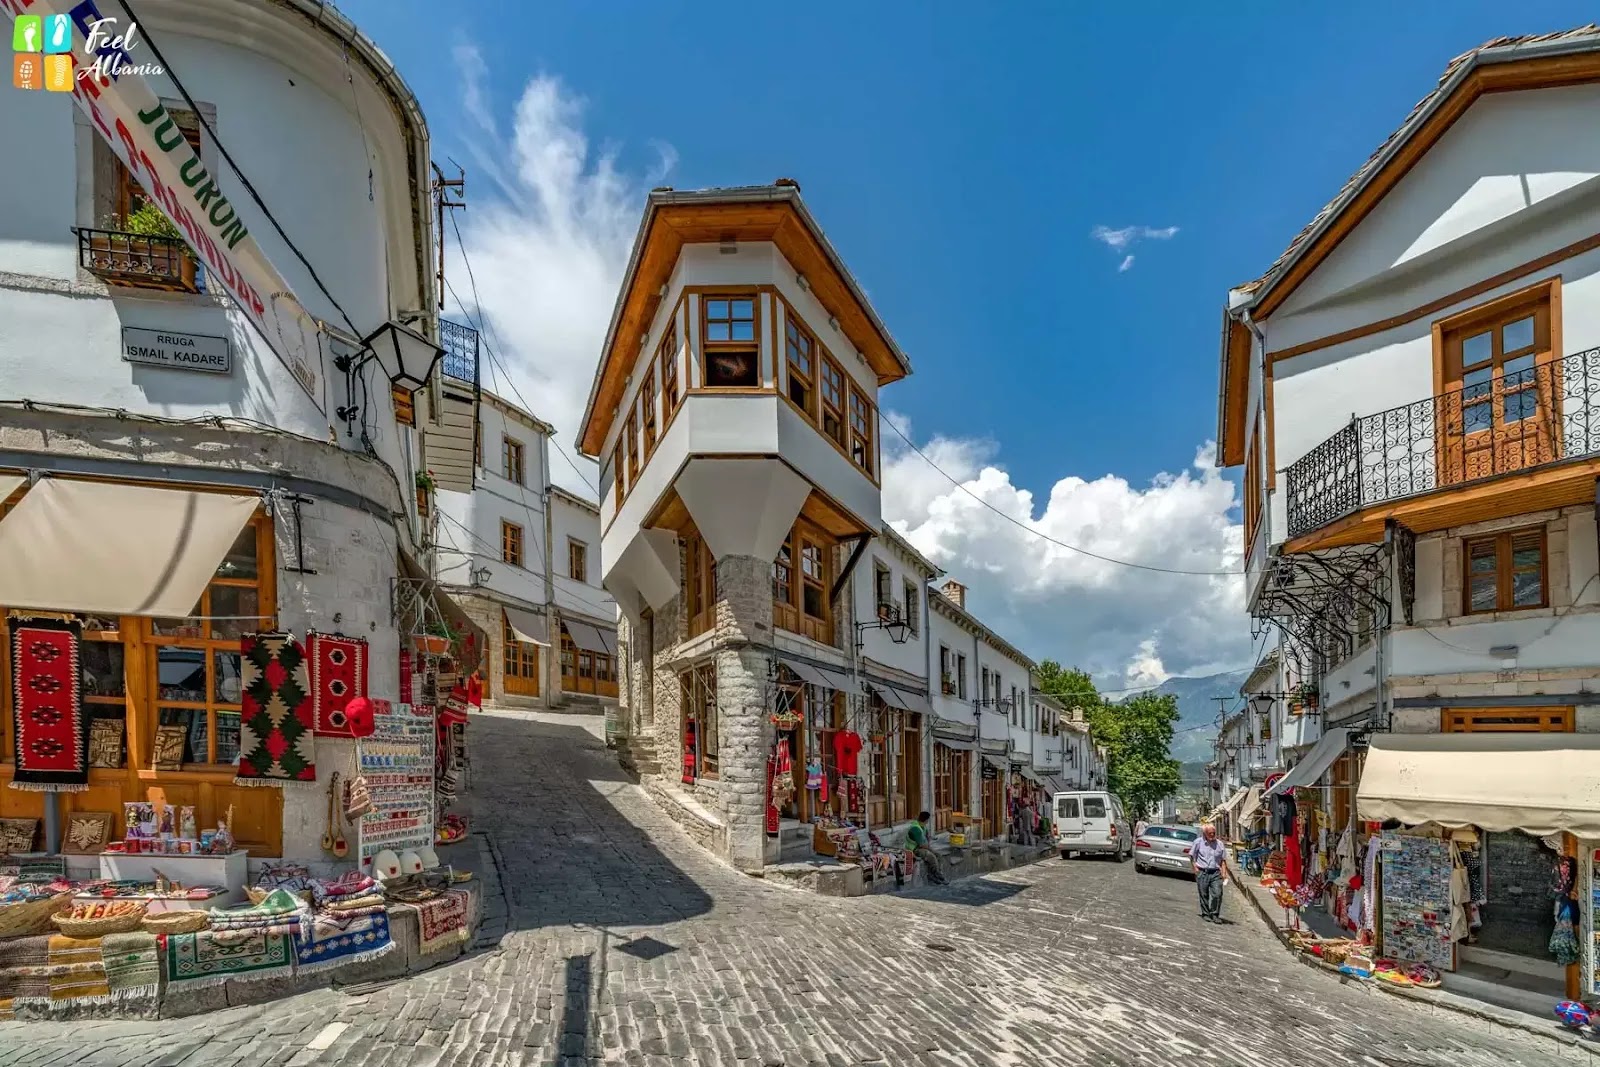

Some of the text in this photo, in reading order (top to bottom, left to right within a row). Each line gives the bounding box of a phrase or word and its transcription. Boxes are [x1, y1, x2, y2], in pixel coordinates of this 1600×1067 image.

[138, 102, 248, 250] JU URON
[157, 335, 195, 347] RRUGA
[127, 345, 225, 366] ISMAIL KADARE
